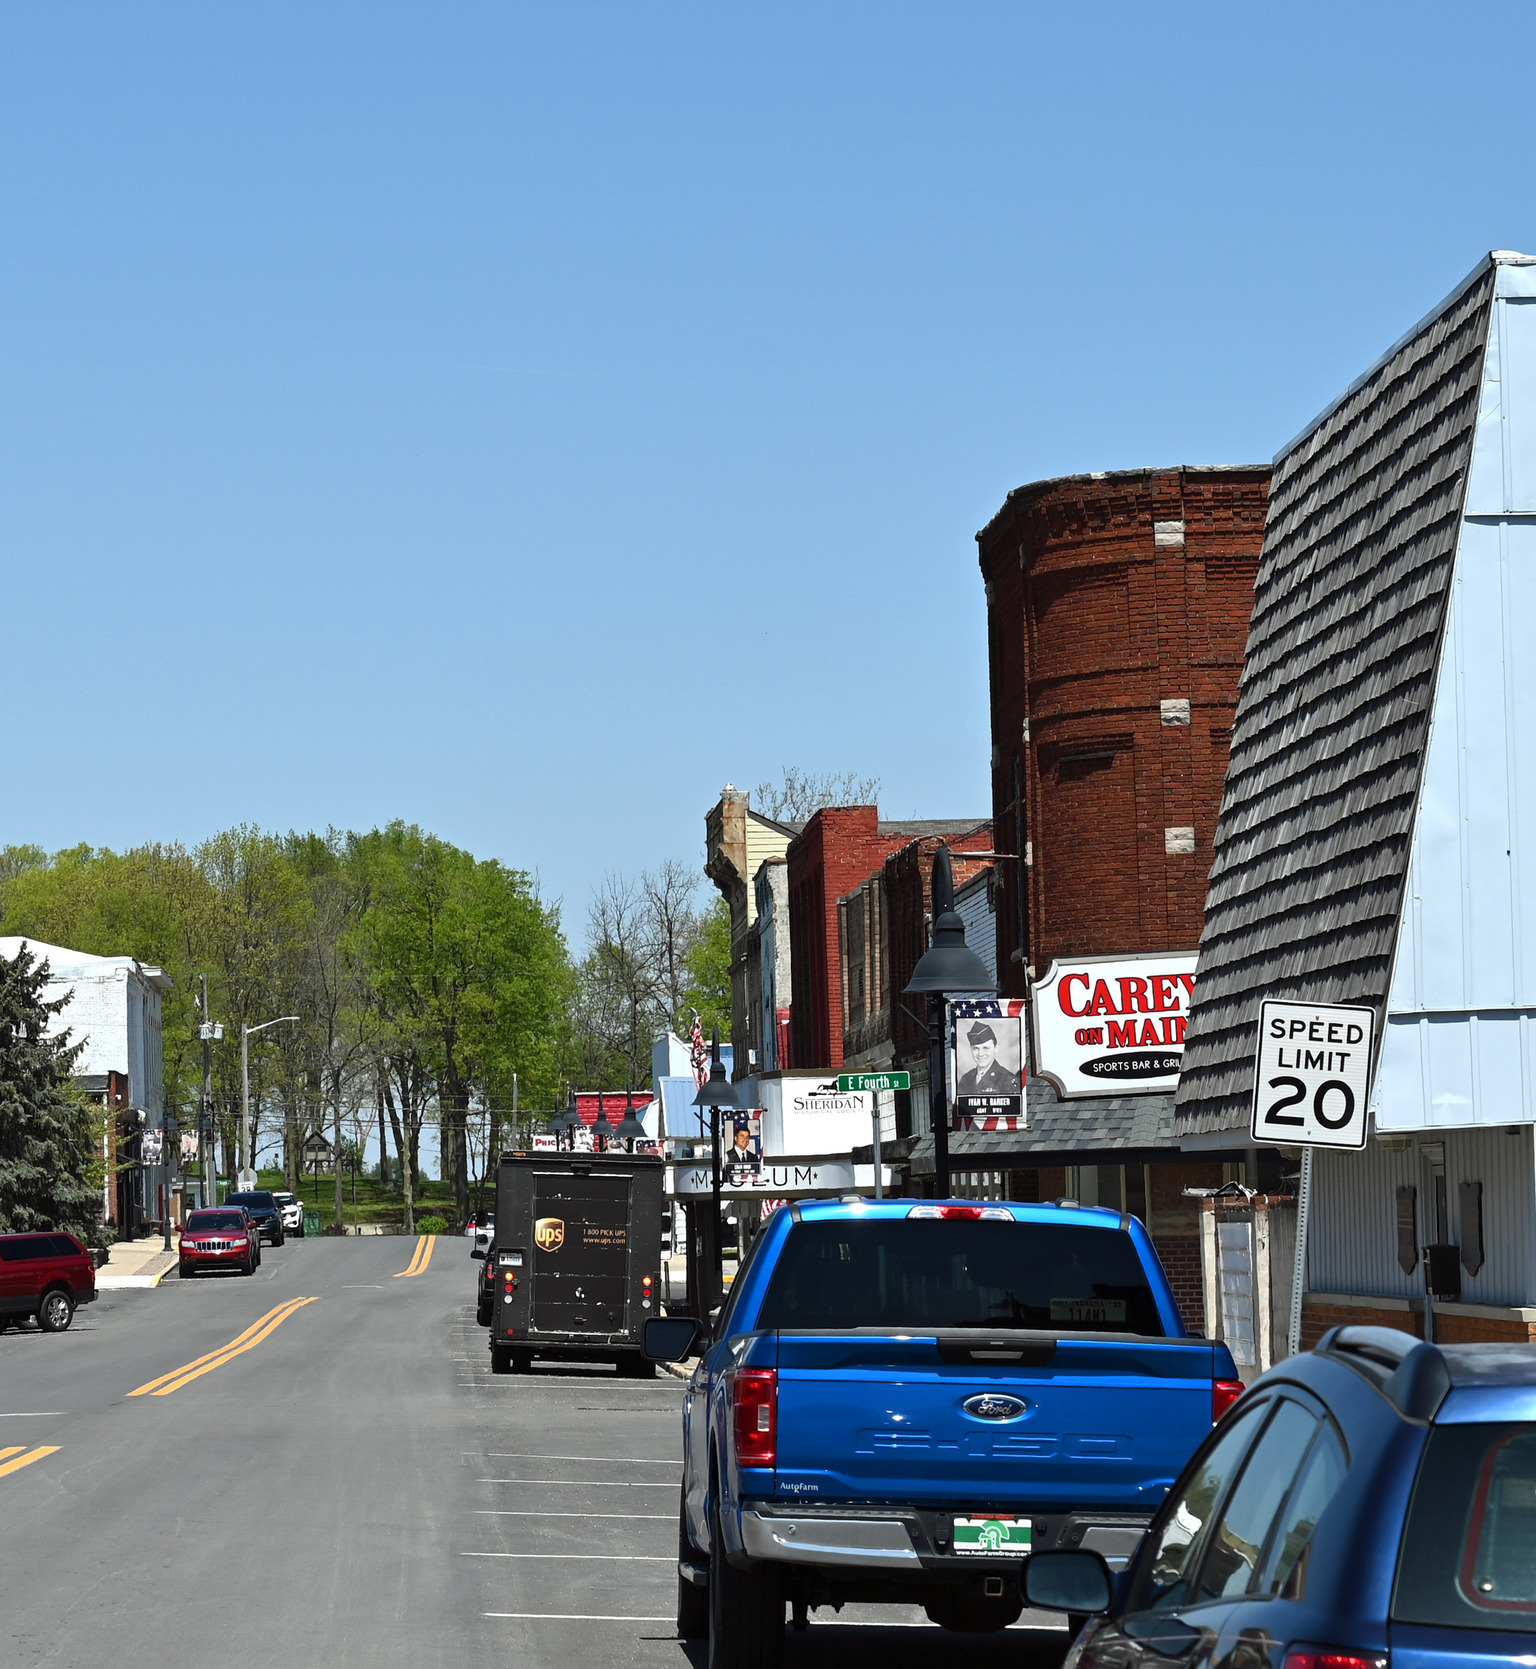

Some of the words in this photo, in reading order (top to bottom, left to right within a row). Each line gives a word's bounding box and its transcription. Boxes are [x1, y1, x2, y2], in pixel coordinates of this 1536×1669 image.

[1075, 1027, 1104, 1045] ON
[1270, 1018, 1363, 1045] SPEED
[1093, 1061, 1130, 1073] SPORTS
[1132, 1060, 1151, 1070] BAR
[1153, 1059, 1161, 1069] &
[1278, 1047, 1351, 1072] LIMIT
[848, 1077, 855, 1090] E
[859, 1075, 890, 1089] Fourth
[794, 1095, 864, 1110] SHERIDAN
[1265, 1075, 1355, 1130] 20
[695, 1166, 813, 1190] MUM
[537, 1228, 563, 1247] ups
[587, 1228, 600, 1236] 800
[600, 1229, 614, 1237] PICK
[614, 1229, 627, 1237] UPS
[978, 1400, 1013, 1415] Ford
[780, 1482, 819, 1493] AutoFarm
